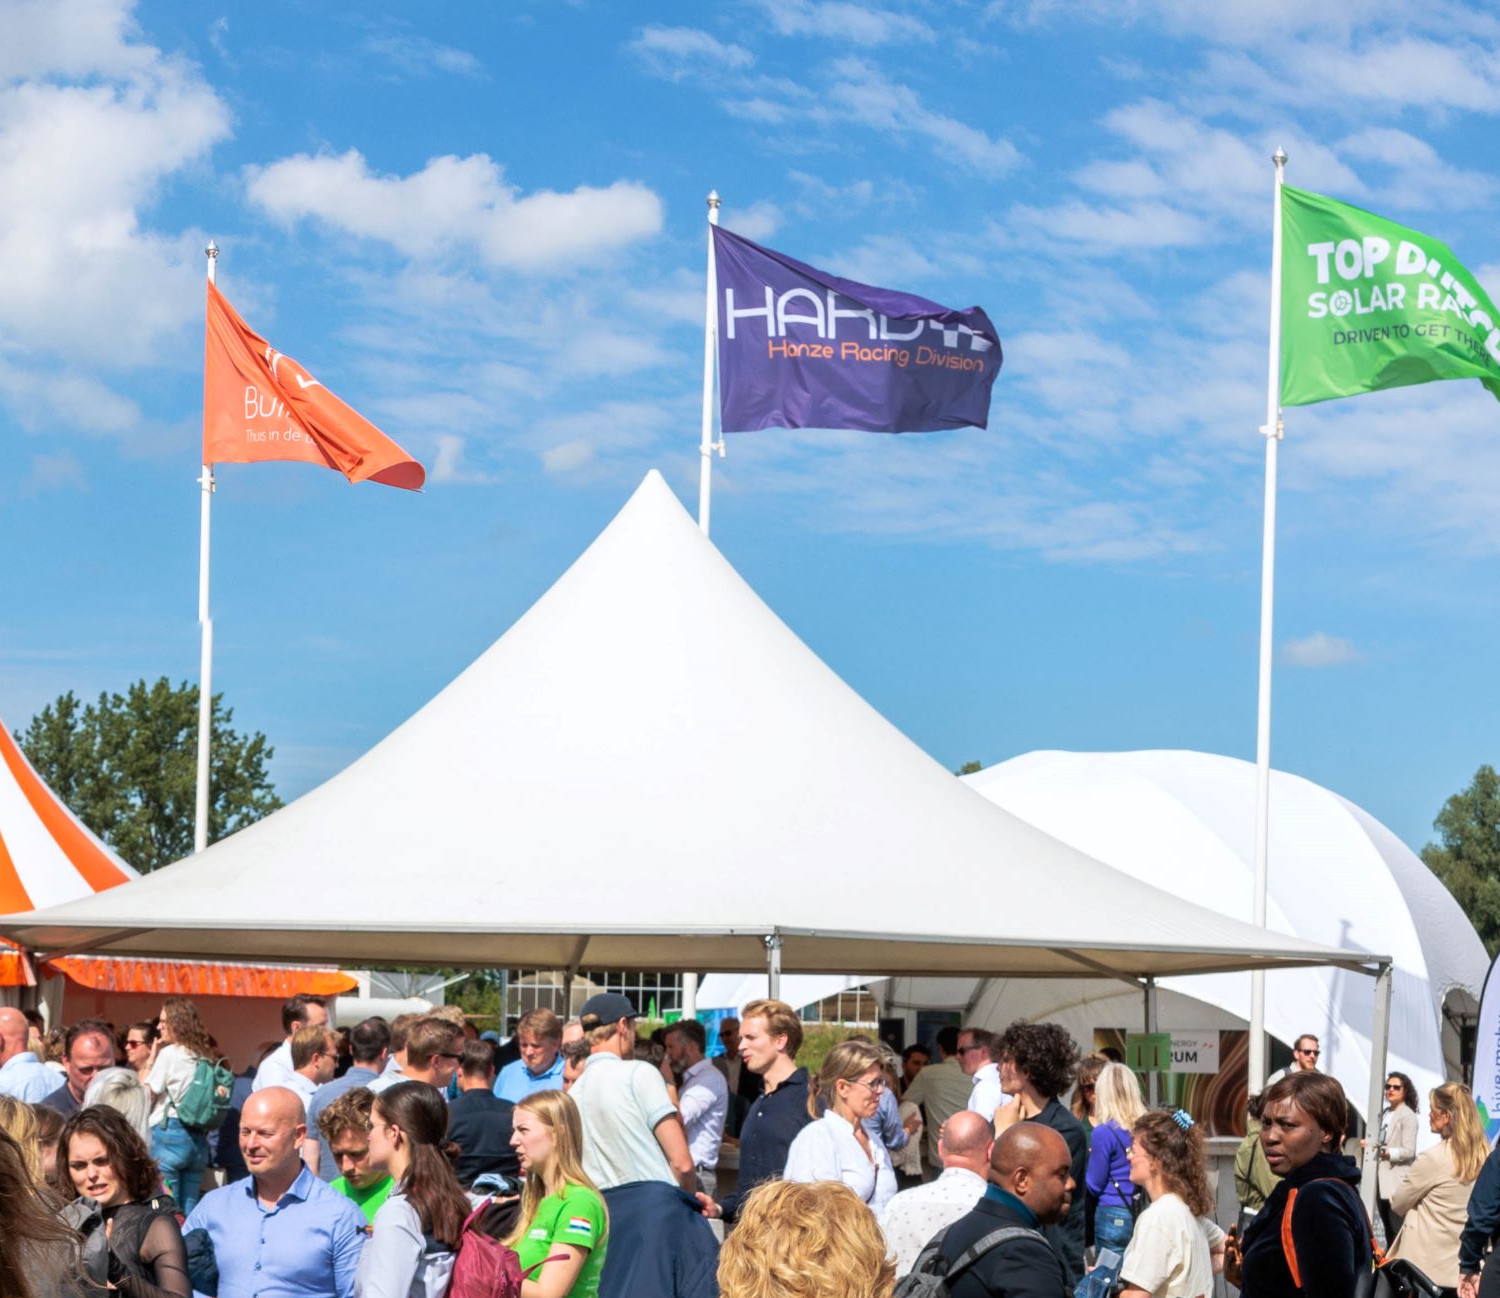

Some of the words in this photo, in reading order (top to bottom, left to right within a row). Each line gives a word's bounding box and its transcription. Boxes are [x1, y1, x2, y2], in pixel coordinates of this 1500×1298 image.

[1307, 237, 1391, 285] TOP
[1307, 283, 1406, 319] SOLAR
[768, 339, 834, 360] Hanze
[841, 341, 910, 368] Racing
[915, 346, 985, 373] Division
[1333, 326, 1390, 346] DRIVEN
[1392, 323, 1410, 339] TO
[1415, 323, 1451, 338] GET
[1454, 328, 1491, 368] THERE
[246, 429, 267, 443] Thuis
[268, 430, 280, 441] in
[283, 427, 301, 441] de
[1170, 1039, 1198, 1047] NERGY
